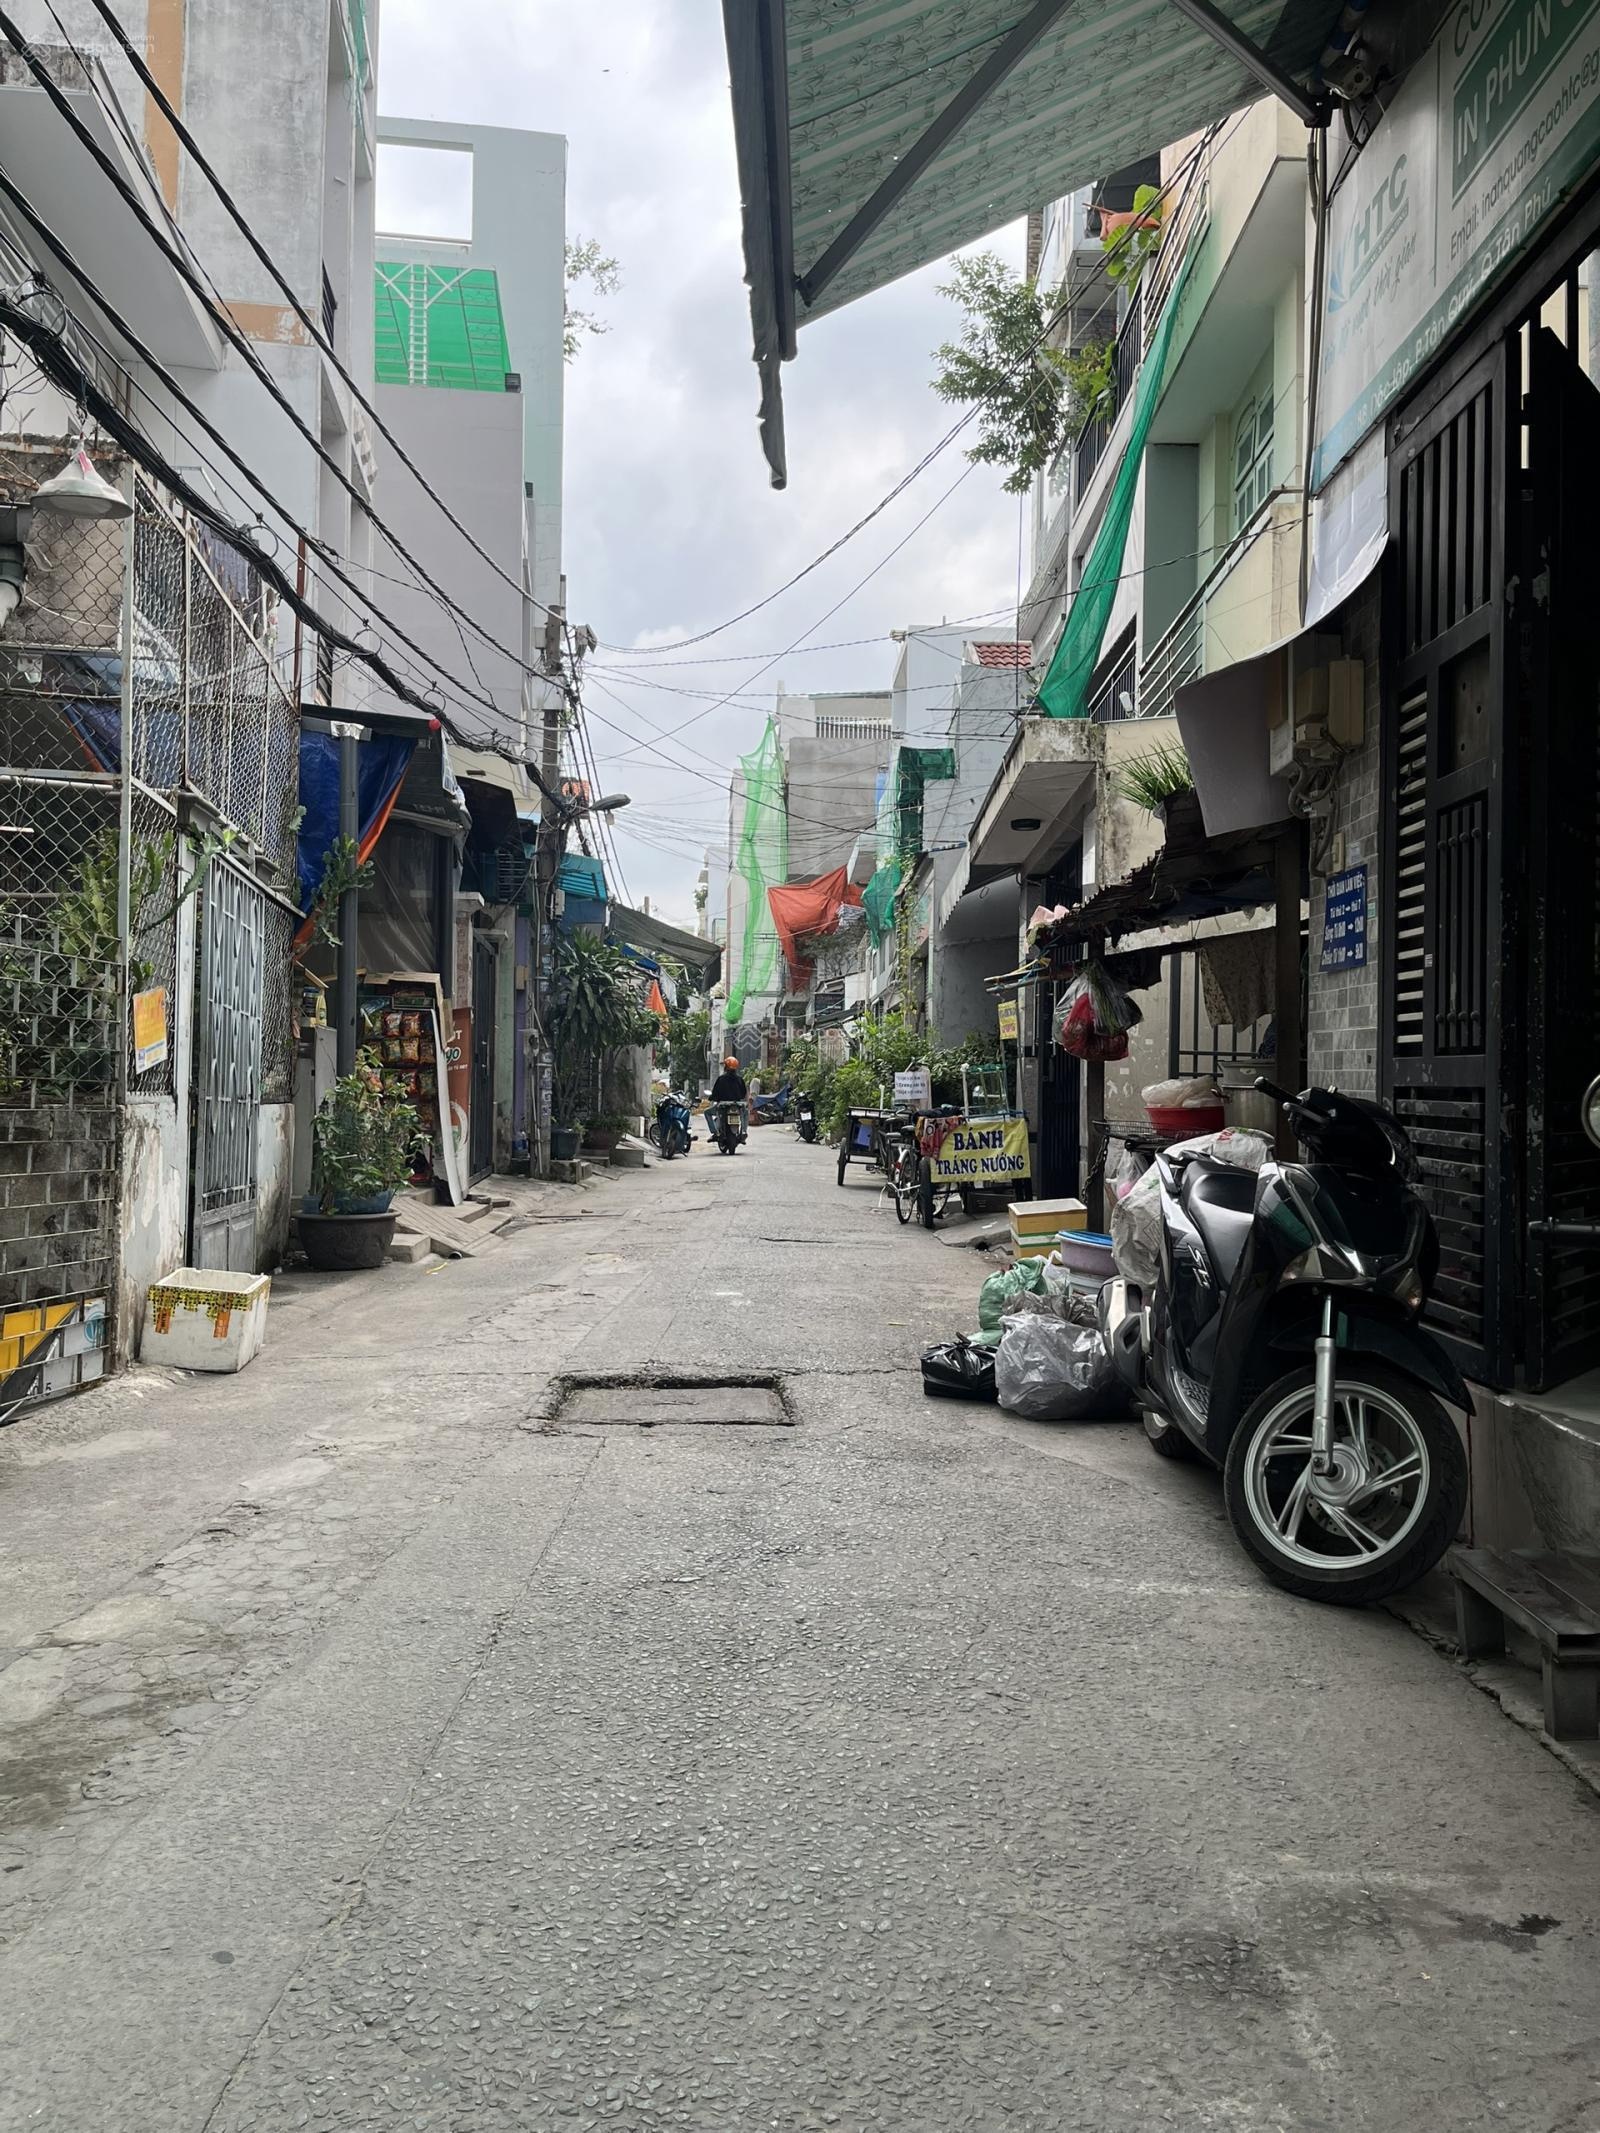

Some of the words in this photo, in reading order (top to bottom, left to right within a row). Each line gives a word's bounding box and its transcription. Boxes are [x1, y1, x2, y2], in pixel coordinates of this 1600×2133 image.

[1457, 91, 1479, 166] IN
[1485, 0, 1552, 124] PHUN
[1353, 153, 1408, 273] HTC
[1523, 175, 1553, 231] Phú
[1450, 203, 1480, 262] Email:
[936, 1155, 978, 1175] TRÁNG
[980, 1152, 1025, 1173] NƯỚNG
[953, 1127, 1004, 1151] BÁNH
